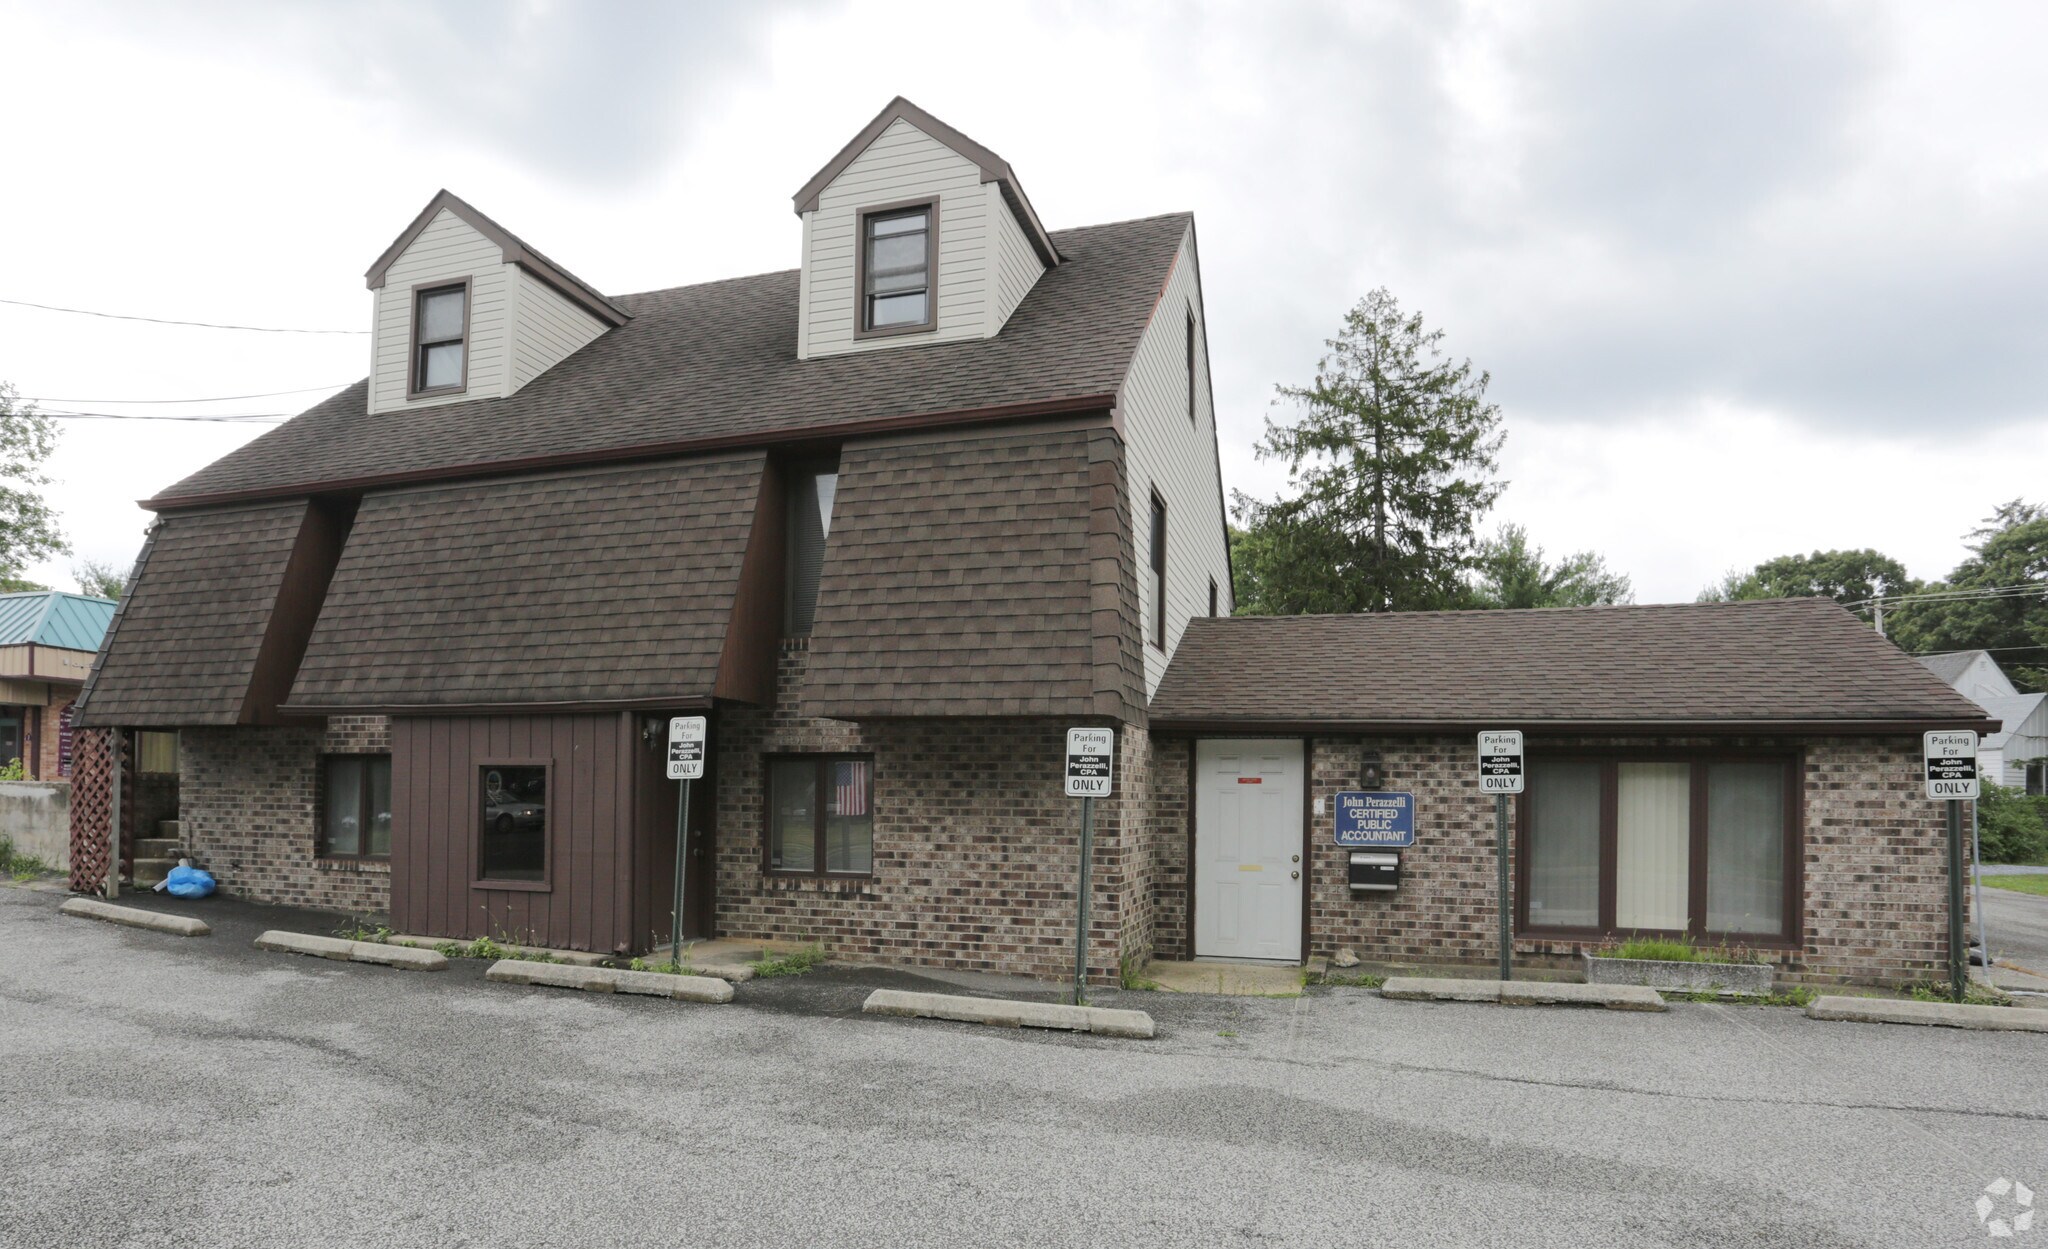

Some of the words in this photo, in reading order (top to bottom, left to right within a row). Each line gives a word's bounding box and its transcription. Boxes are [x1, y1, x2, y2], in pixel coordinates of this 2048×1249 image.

[675, 721, 701, 731] Parking
[1074, 733, 1107, 744] Parking
[1484, 735, 1516, 745] Parking
[1931, 736, 1969, 746] Parking
[1082, 744, 1096, 752] For
[1943, 747, 1958, 755] For
[673, 763, 697, 773] ONLY
[1072, 779, 1104, 790] ONLY
[1486, 778, 1516, 788] ONLY
[1934, 782, 1970, 793] ONLY
[1343, 796, 1364, 808] John
[1366, 796, 1406, 807] Perazzelli
[1349, 809, 1398, 818] CERTIFIED
[1357, 820, 1392, 829] PUBLIC
[1341, 831, 1406, 841] ACCOUNTANT
